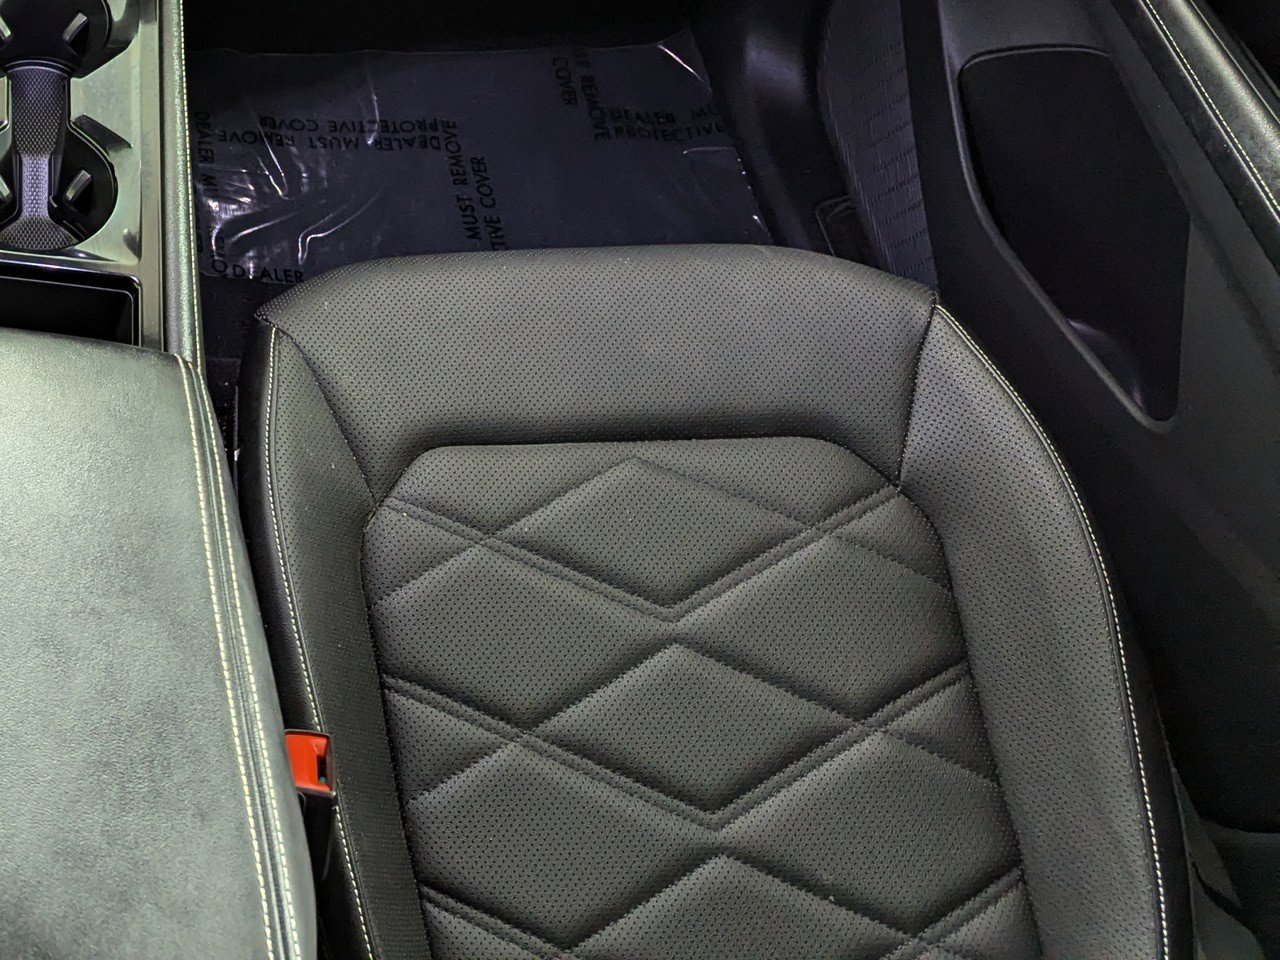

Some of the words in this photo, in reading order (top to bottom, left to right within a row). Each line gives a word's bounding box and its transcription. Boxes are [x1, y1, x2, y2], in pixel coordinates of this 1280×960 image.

[307, 134, 360, 150] MUST
[373, 135, 442, 152] DEALER
[441, 119, 469, 187] REMOVE
[470, 154, 495, 210] COVER
[455, 196, 483, 242] MUST
